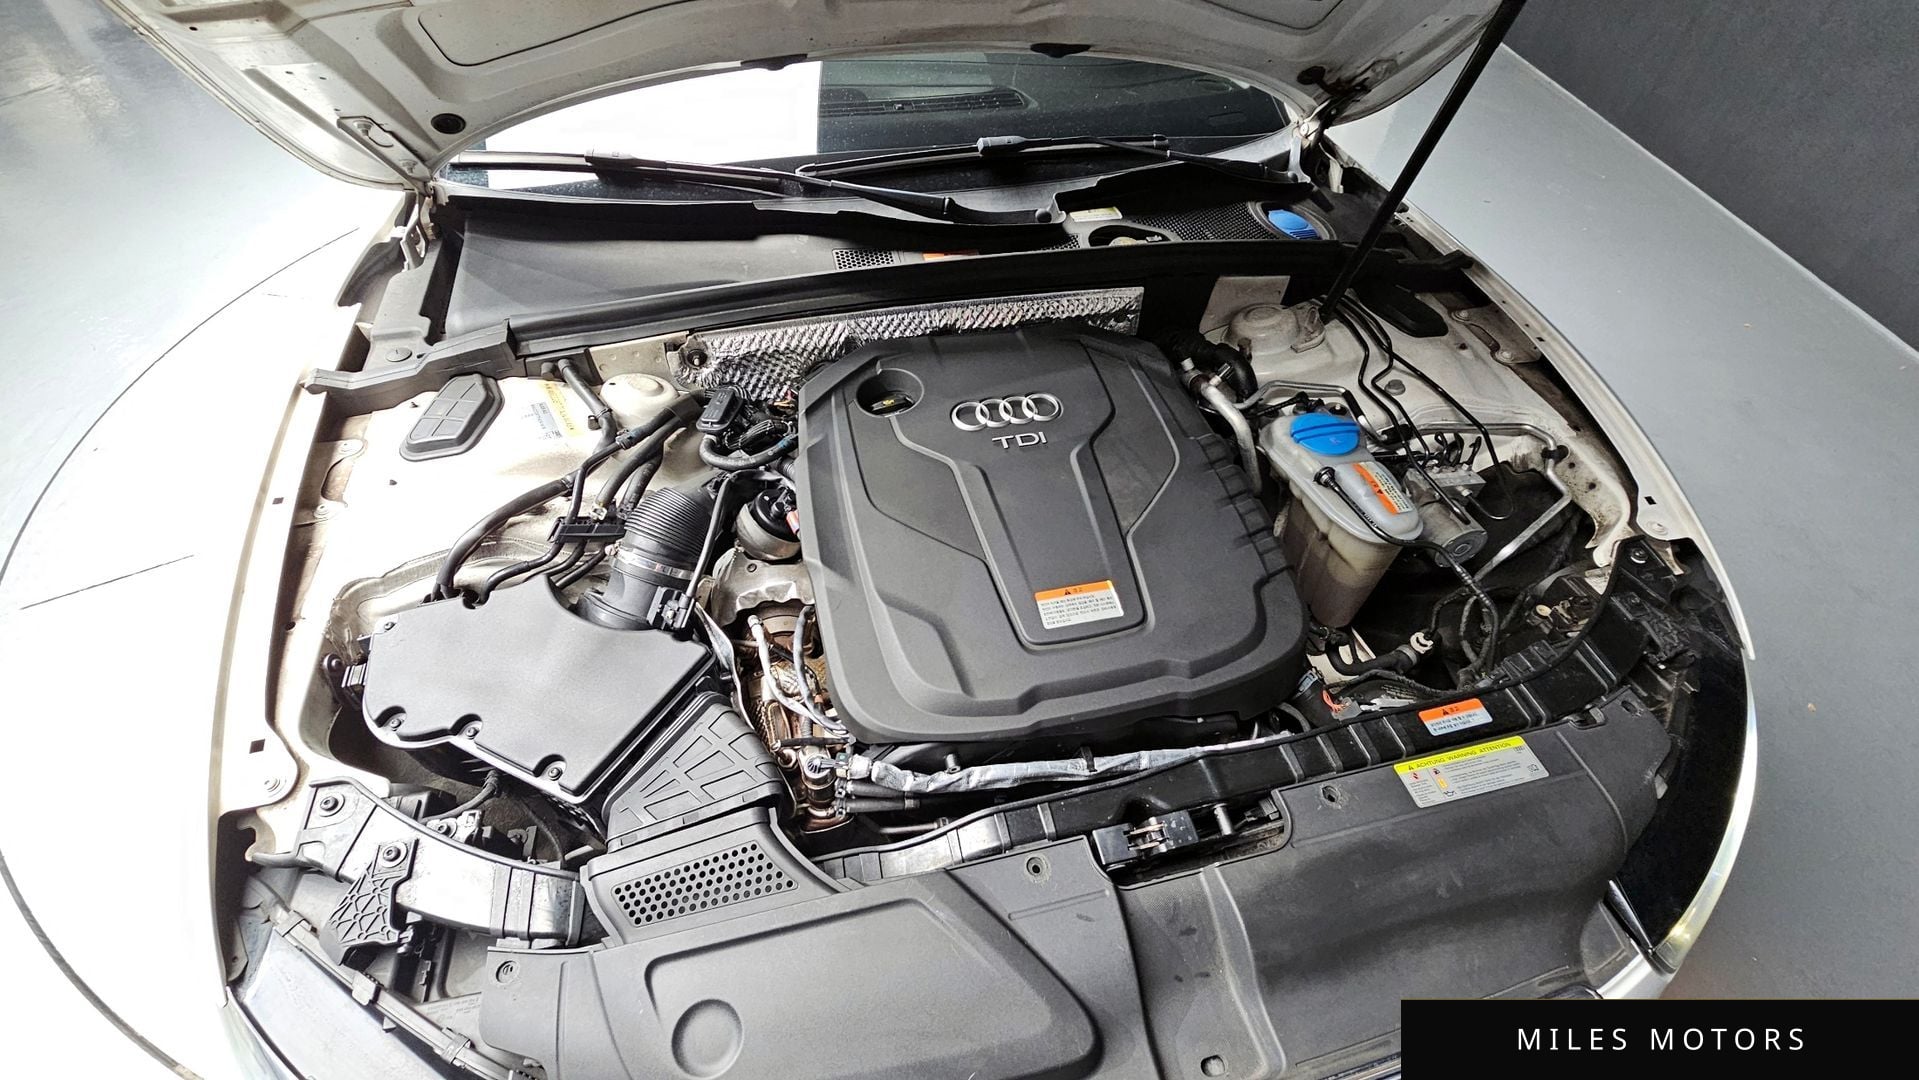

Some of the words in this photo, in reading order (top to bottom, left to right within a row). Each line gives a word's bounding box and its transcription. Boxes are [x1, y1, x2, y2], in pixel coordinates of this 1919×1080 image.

[992, 431, 1047, 449] TDI
[1416, 758, 1446, 769] ACHTUNG
[1447, 750, 1477, 761] WARNING
[1479, 742, 1511, 754] ATTENTION
